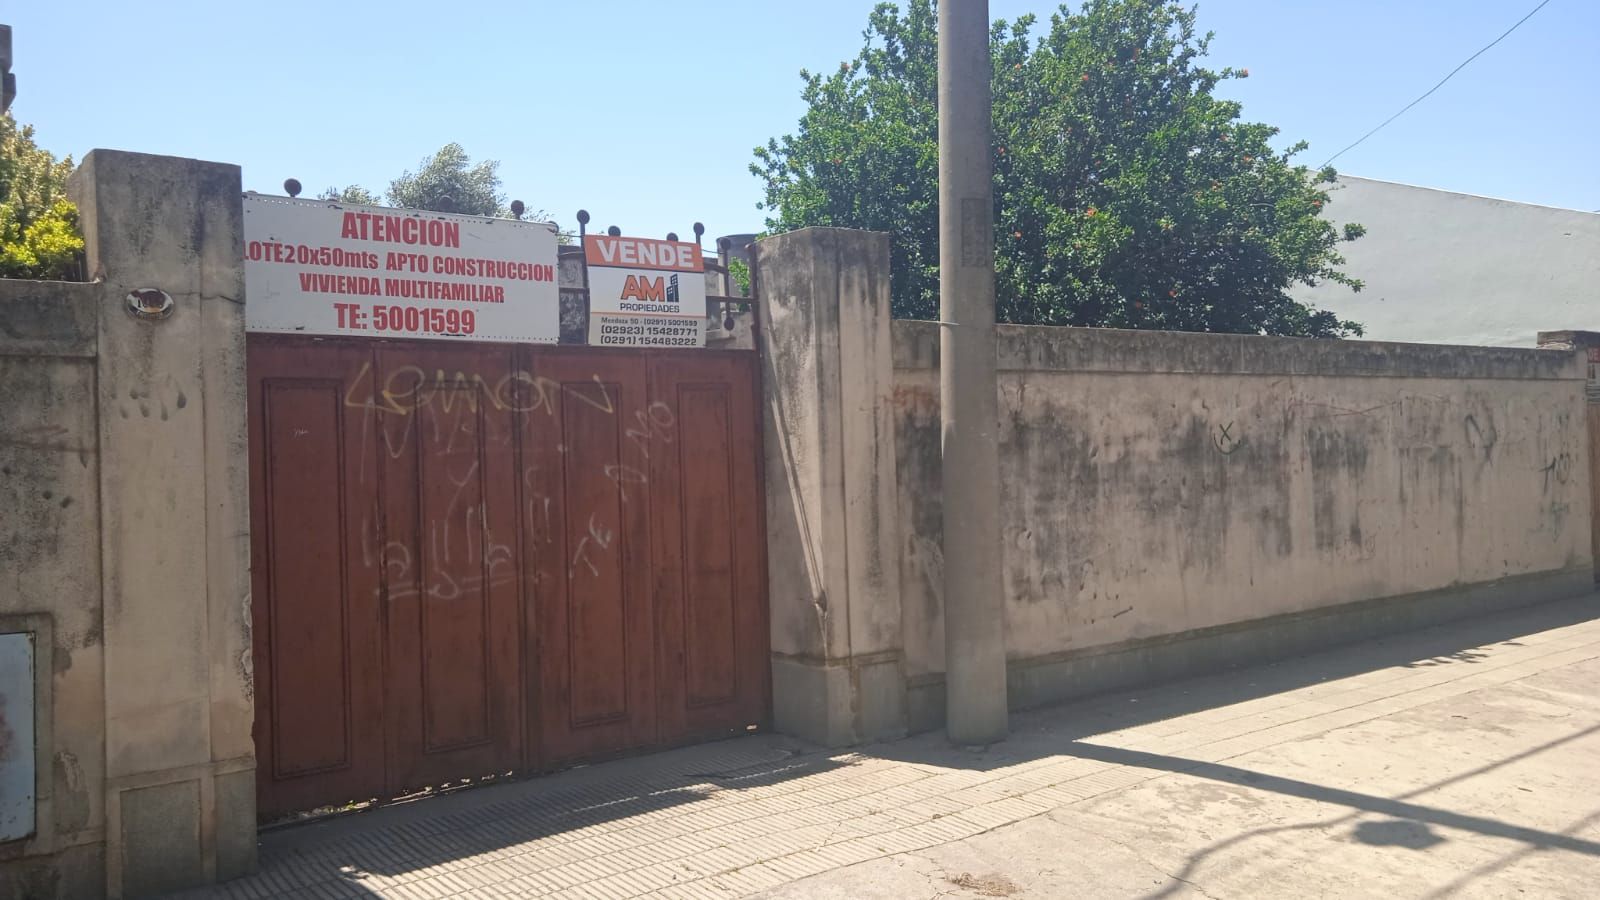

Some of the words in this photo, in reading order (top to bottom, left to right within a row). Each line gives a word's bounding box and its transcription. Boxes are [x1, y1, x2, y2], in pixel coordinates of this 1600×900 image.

[341, 211, 460, 249] ATENCION
[386, 252, 429, 274] APTO
[433, 255, 554, 282] CONSTRUCCION
[596, 239, 695, 268] VENDE
[299, 272, 381, 296] VIVIENDA
[385, 278, 505, 303] MULTIFAMILIAR
[333, 302, 367, 330] TE:
[373, 305, 476, 335] 5001599
[620, 302, 680, 313] PROPIEDADES
[643, 318, 667, 326] (0291)
[600, 335, 636, 345] (0291)
[638, 336, 697, 346] 154483222
[601, 325, 644, 335] (02923)
[646, 326, 698, 337] 15428771
